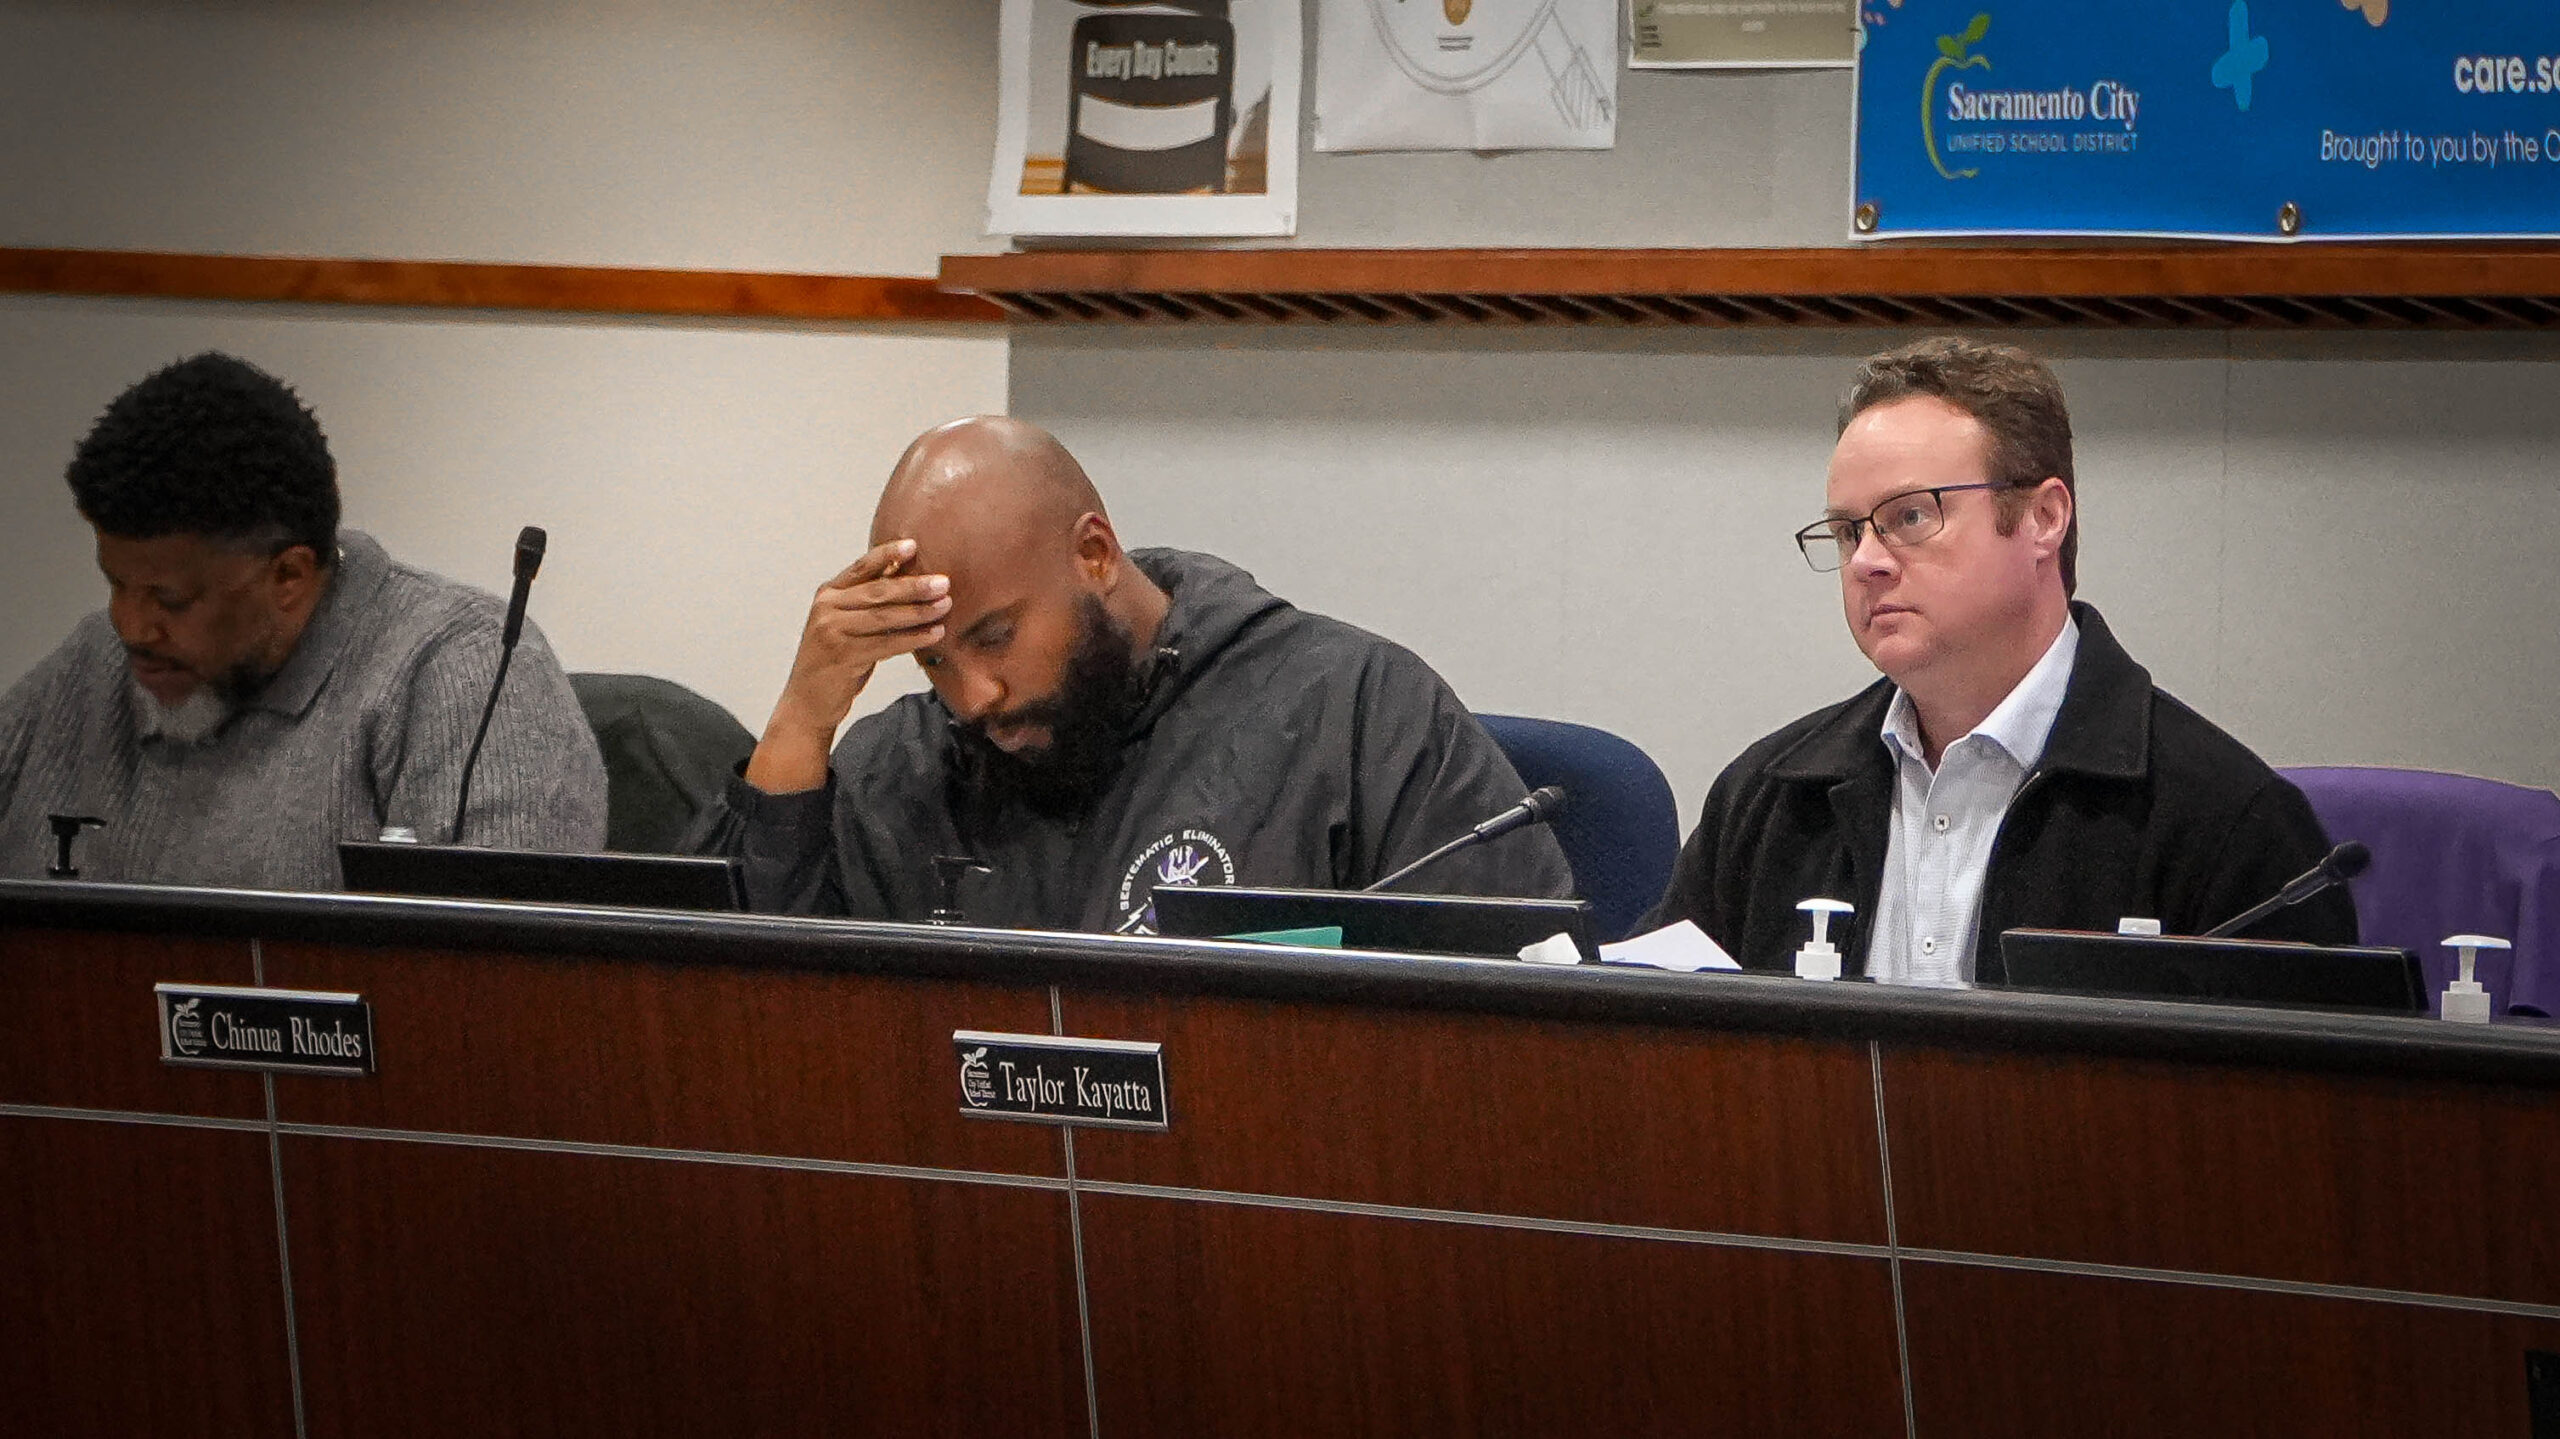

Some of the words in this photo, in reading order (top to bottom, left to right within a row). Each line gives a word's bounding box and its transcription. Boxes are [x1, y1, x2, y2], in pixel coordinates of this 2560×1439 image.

[1087, 40, 1132, 81] Every
[1133, 40, 1163, 80] Day
[1164, 38, 1220, 78] Counts
[1948, 83, 2084, 121] Sacramento
[2091, 81, 2140, 131] City
[1946, 133, 2006, 153] UNIFIED
[2010, 133, 2068, 153] SCHOOL
[2073, 133, 2138, 152] DISTRICT
[2321, 129, 2399, 169] Brought
[2405, 130, 2425, 162] to
[2430, 136, 2467, 169] you
[2472, 130, 2499, 169] by
[2505, 130, 2540, 162] the
[1182, 829, 1236, 886] ELIMINATOR
[211, 1011, 283, 1054] Chinua
[289, 1015, 363, 1059] Rhodes
[999, 1061, 1066, 1112] Taylor
[1073, 1065, 1152, 1118] Kayatta
